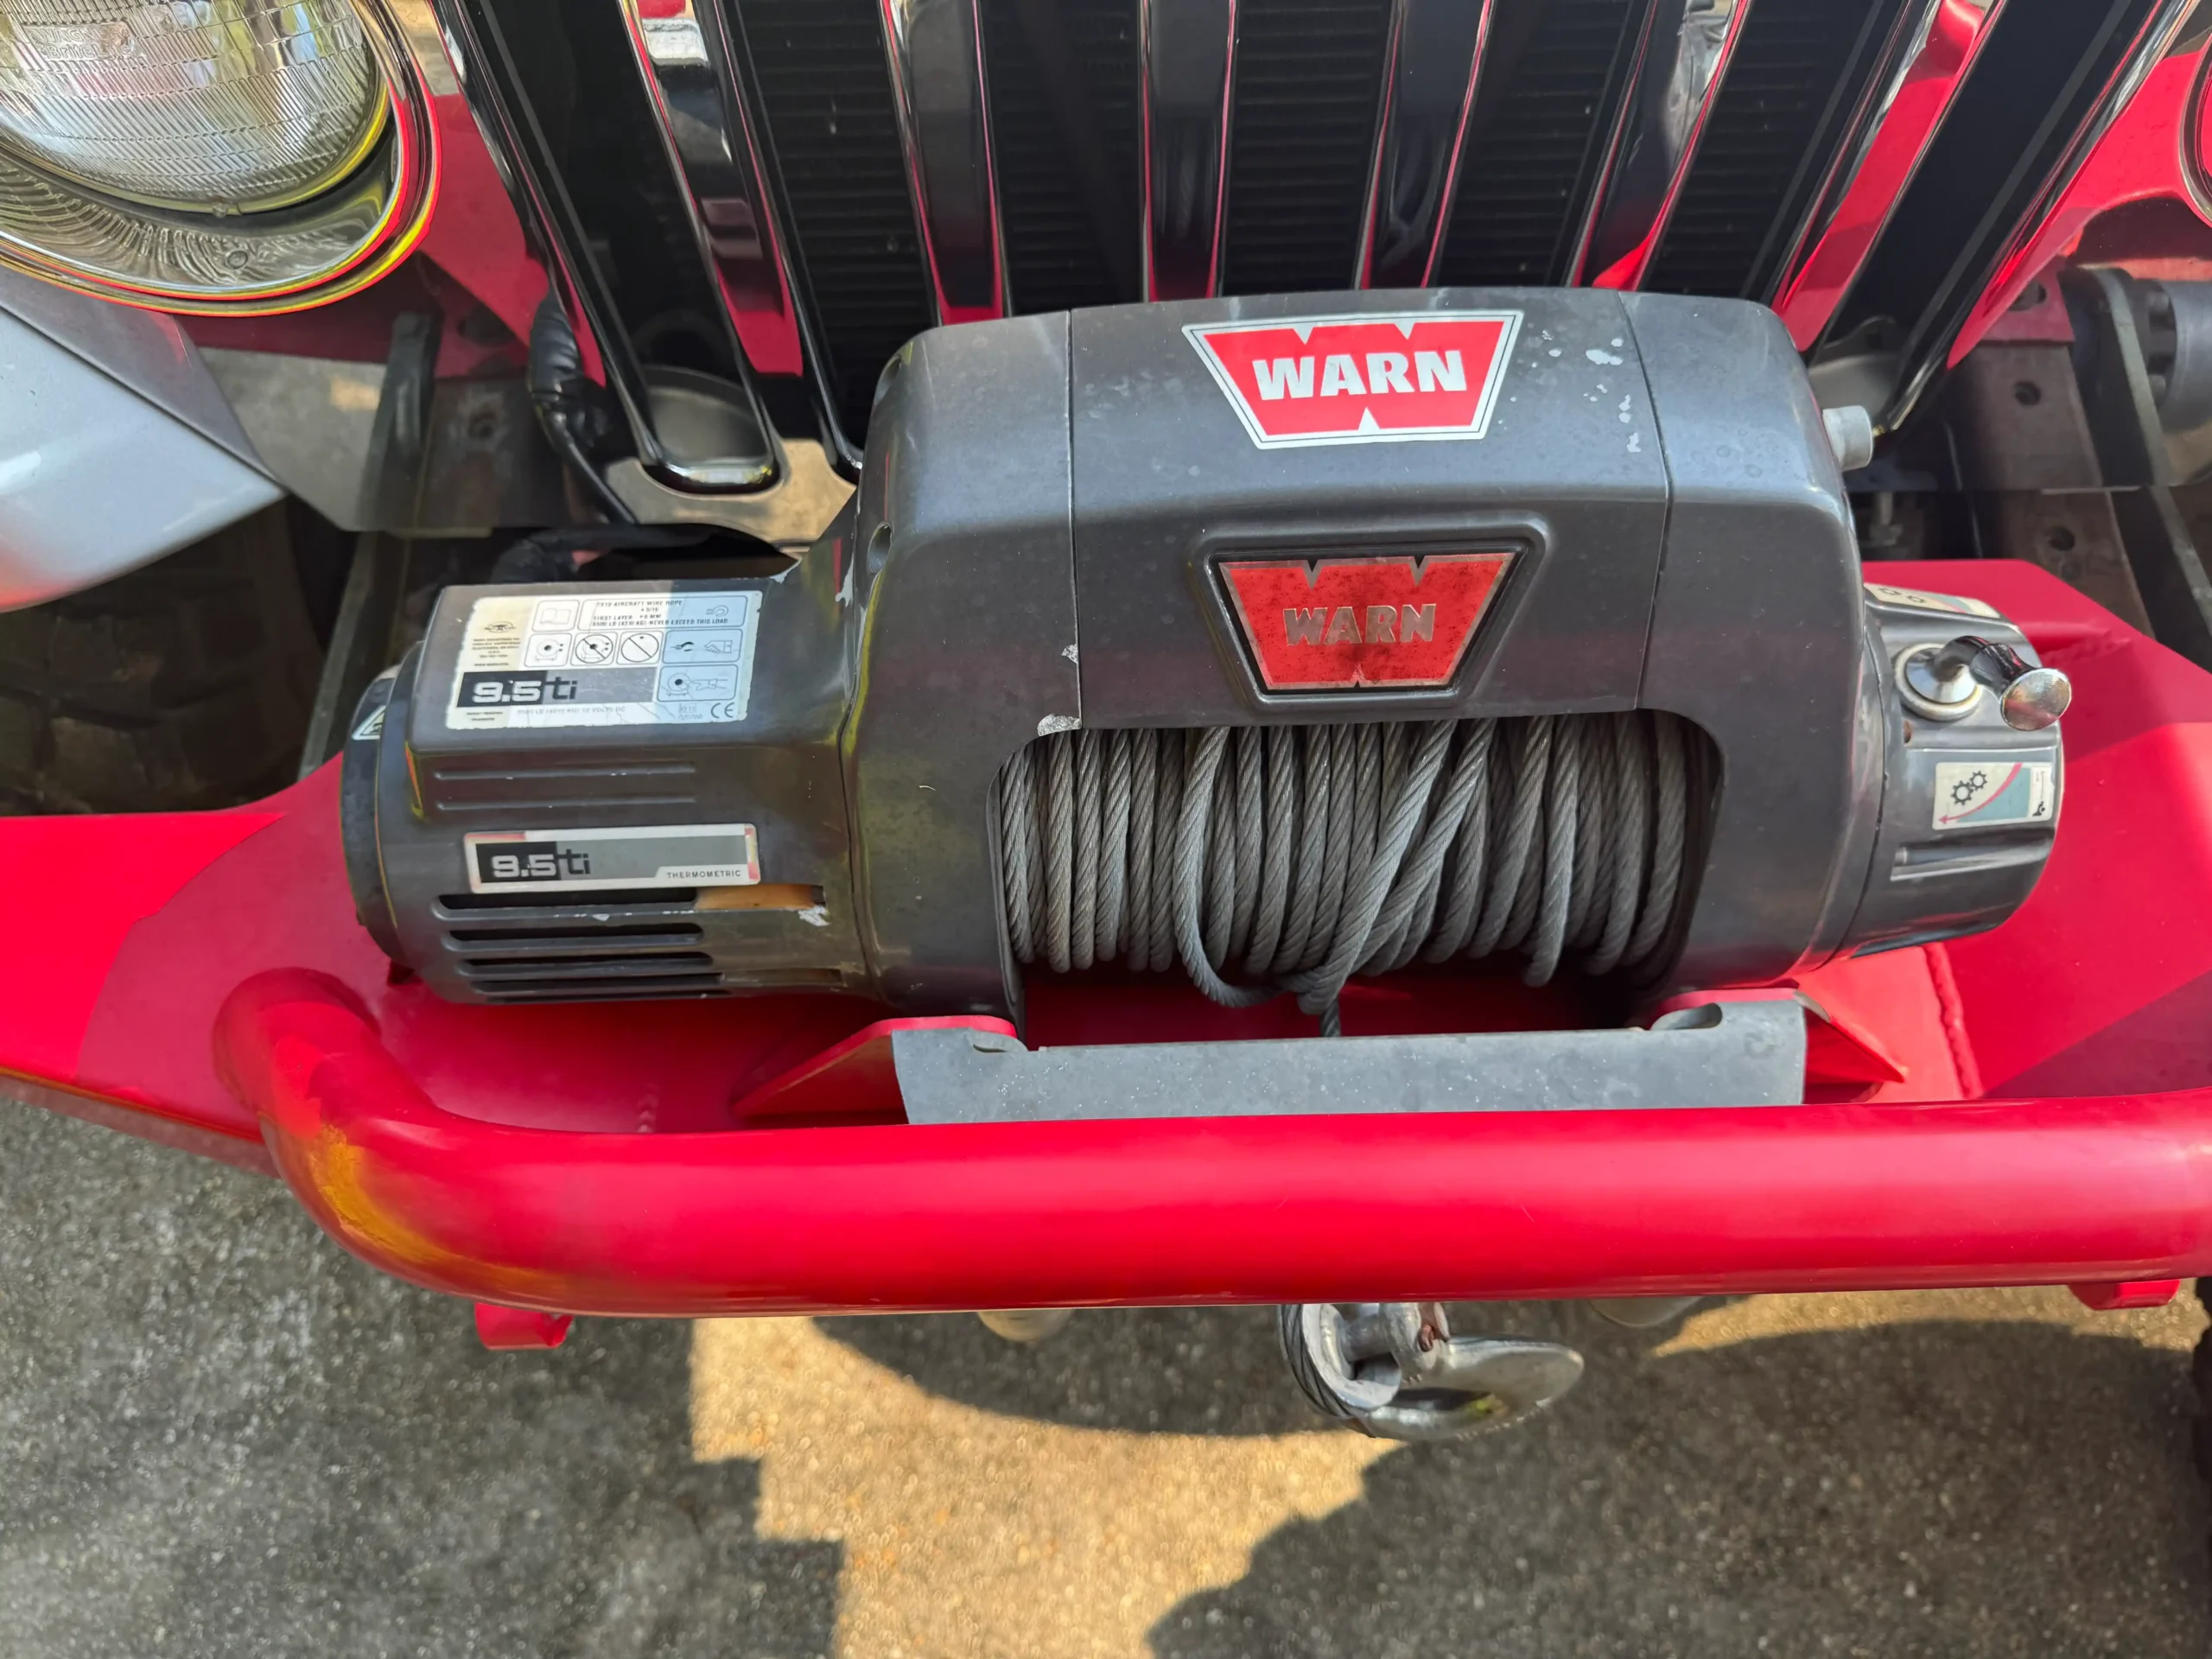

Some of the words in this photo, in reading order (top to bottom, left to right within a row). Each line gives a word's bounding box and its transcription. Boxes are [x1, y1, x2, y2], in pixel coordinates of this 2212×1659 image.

[1252, 350, 1467, 400] WARN
[1282, 603, 1437, 646] WARN
[666, 869, 741, 879] THERMOMETRIC
